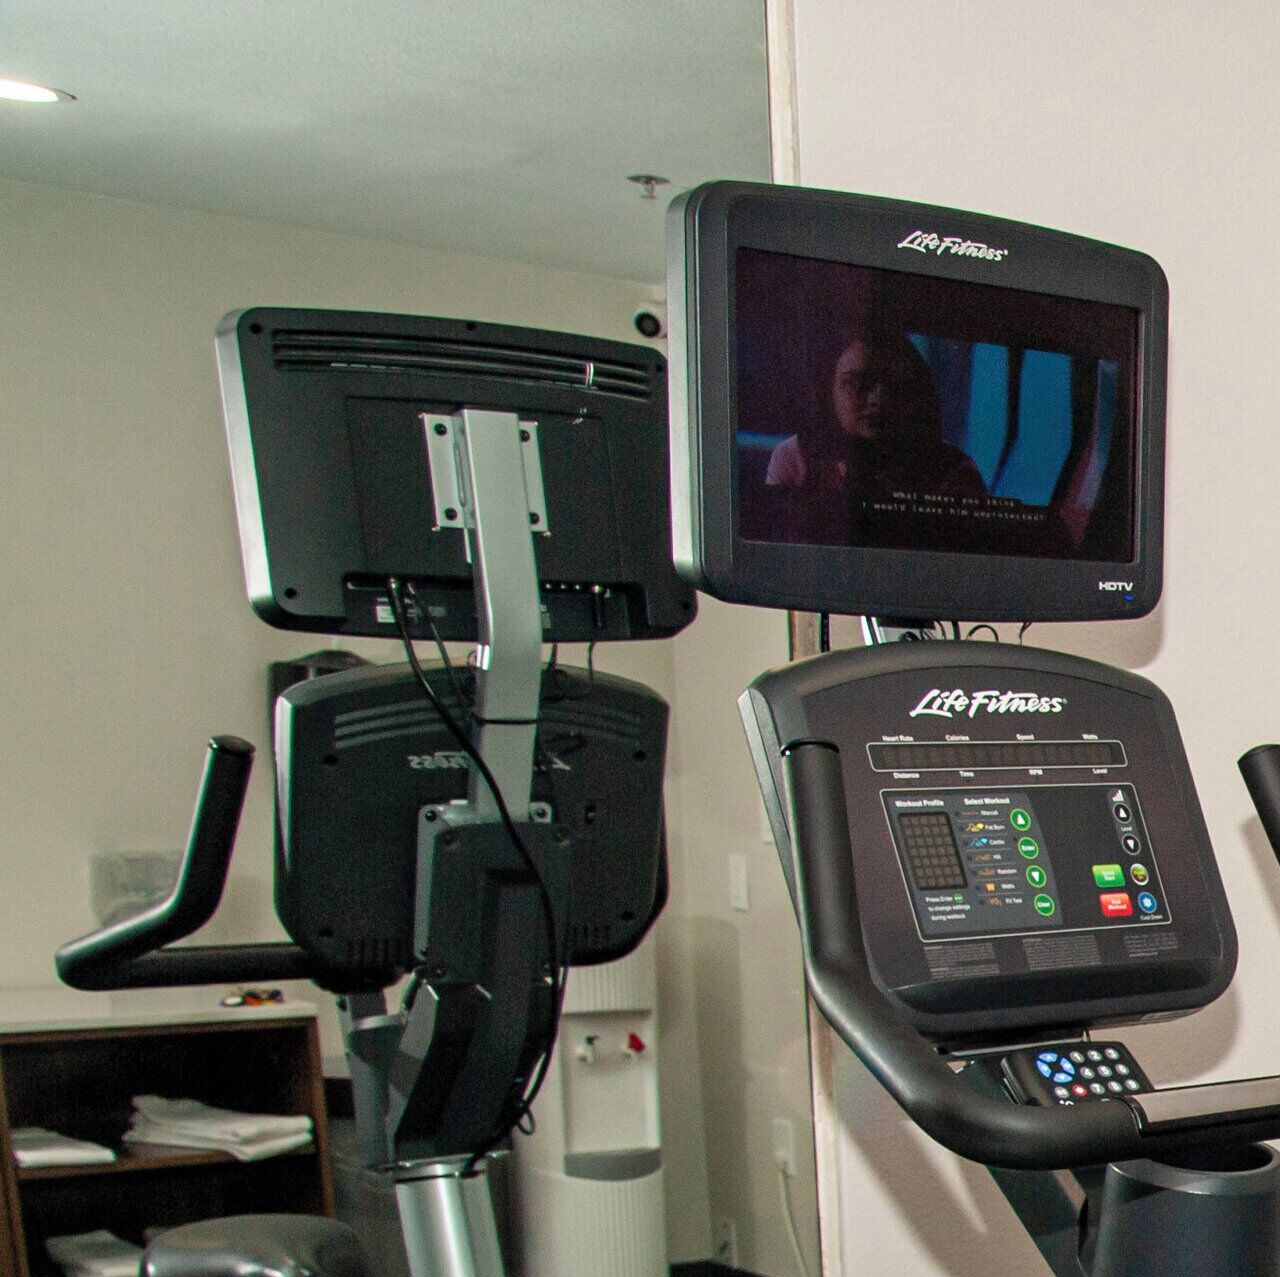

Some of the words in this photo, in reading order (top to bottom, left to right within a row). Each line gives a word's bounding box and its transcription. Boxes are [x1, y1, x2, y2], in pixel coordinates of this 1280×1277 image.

[897, 230, 940, 253] Life
[937, 237, 1002, 261] Fitness
[1098, 581, 1133, 591] HDTV
[909, 689, 969, 718] Life
[968, 690, 1062, 719] Fitness
[923, 799, 944, 807] Profile
